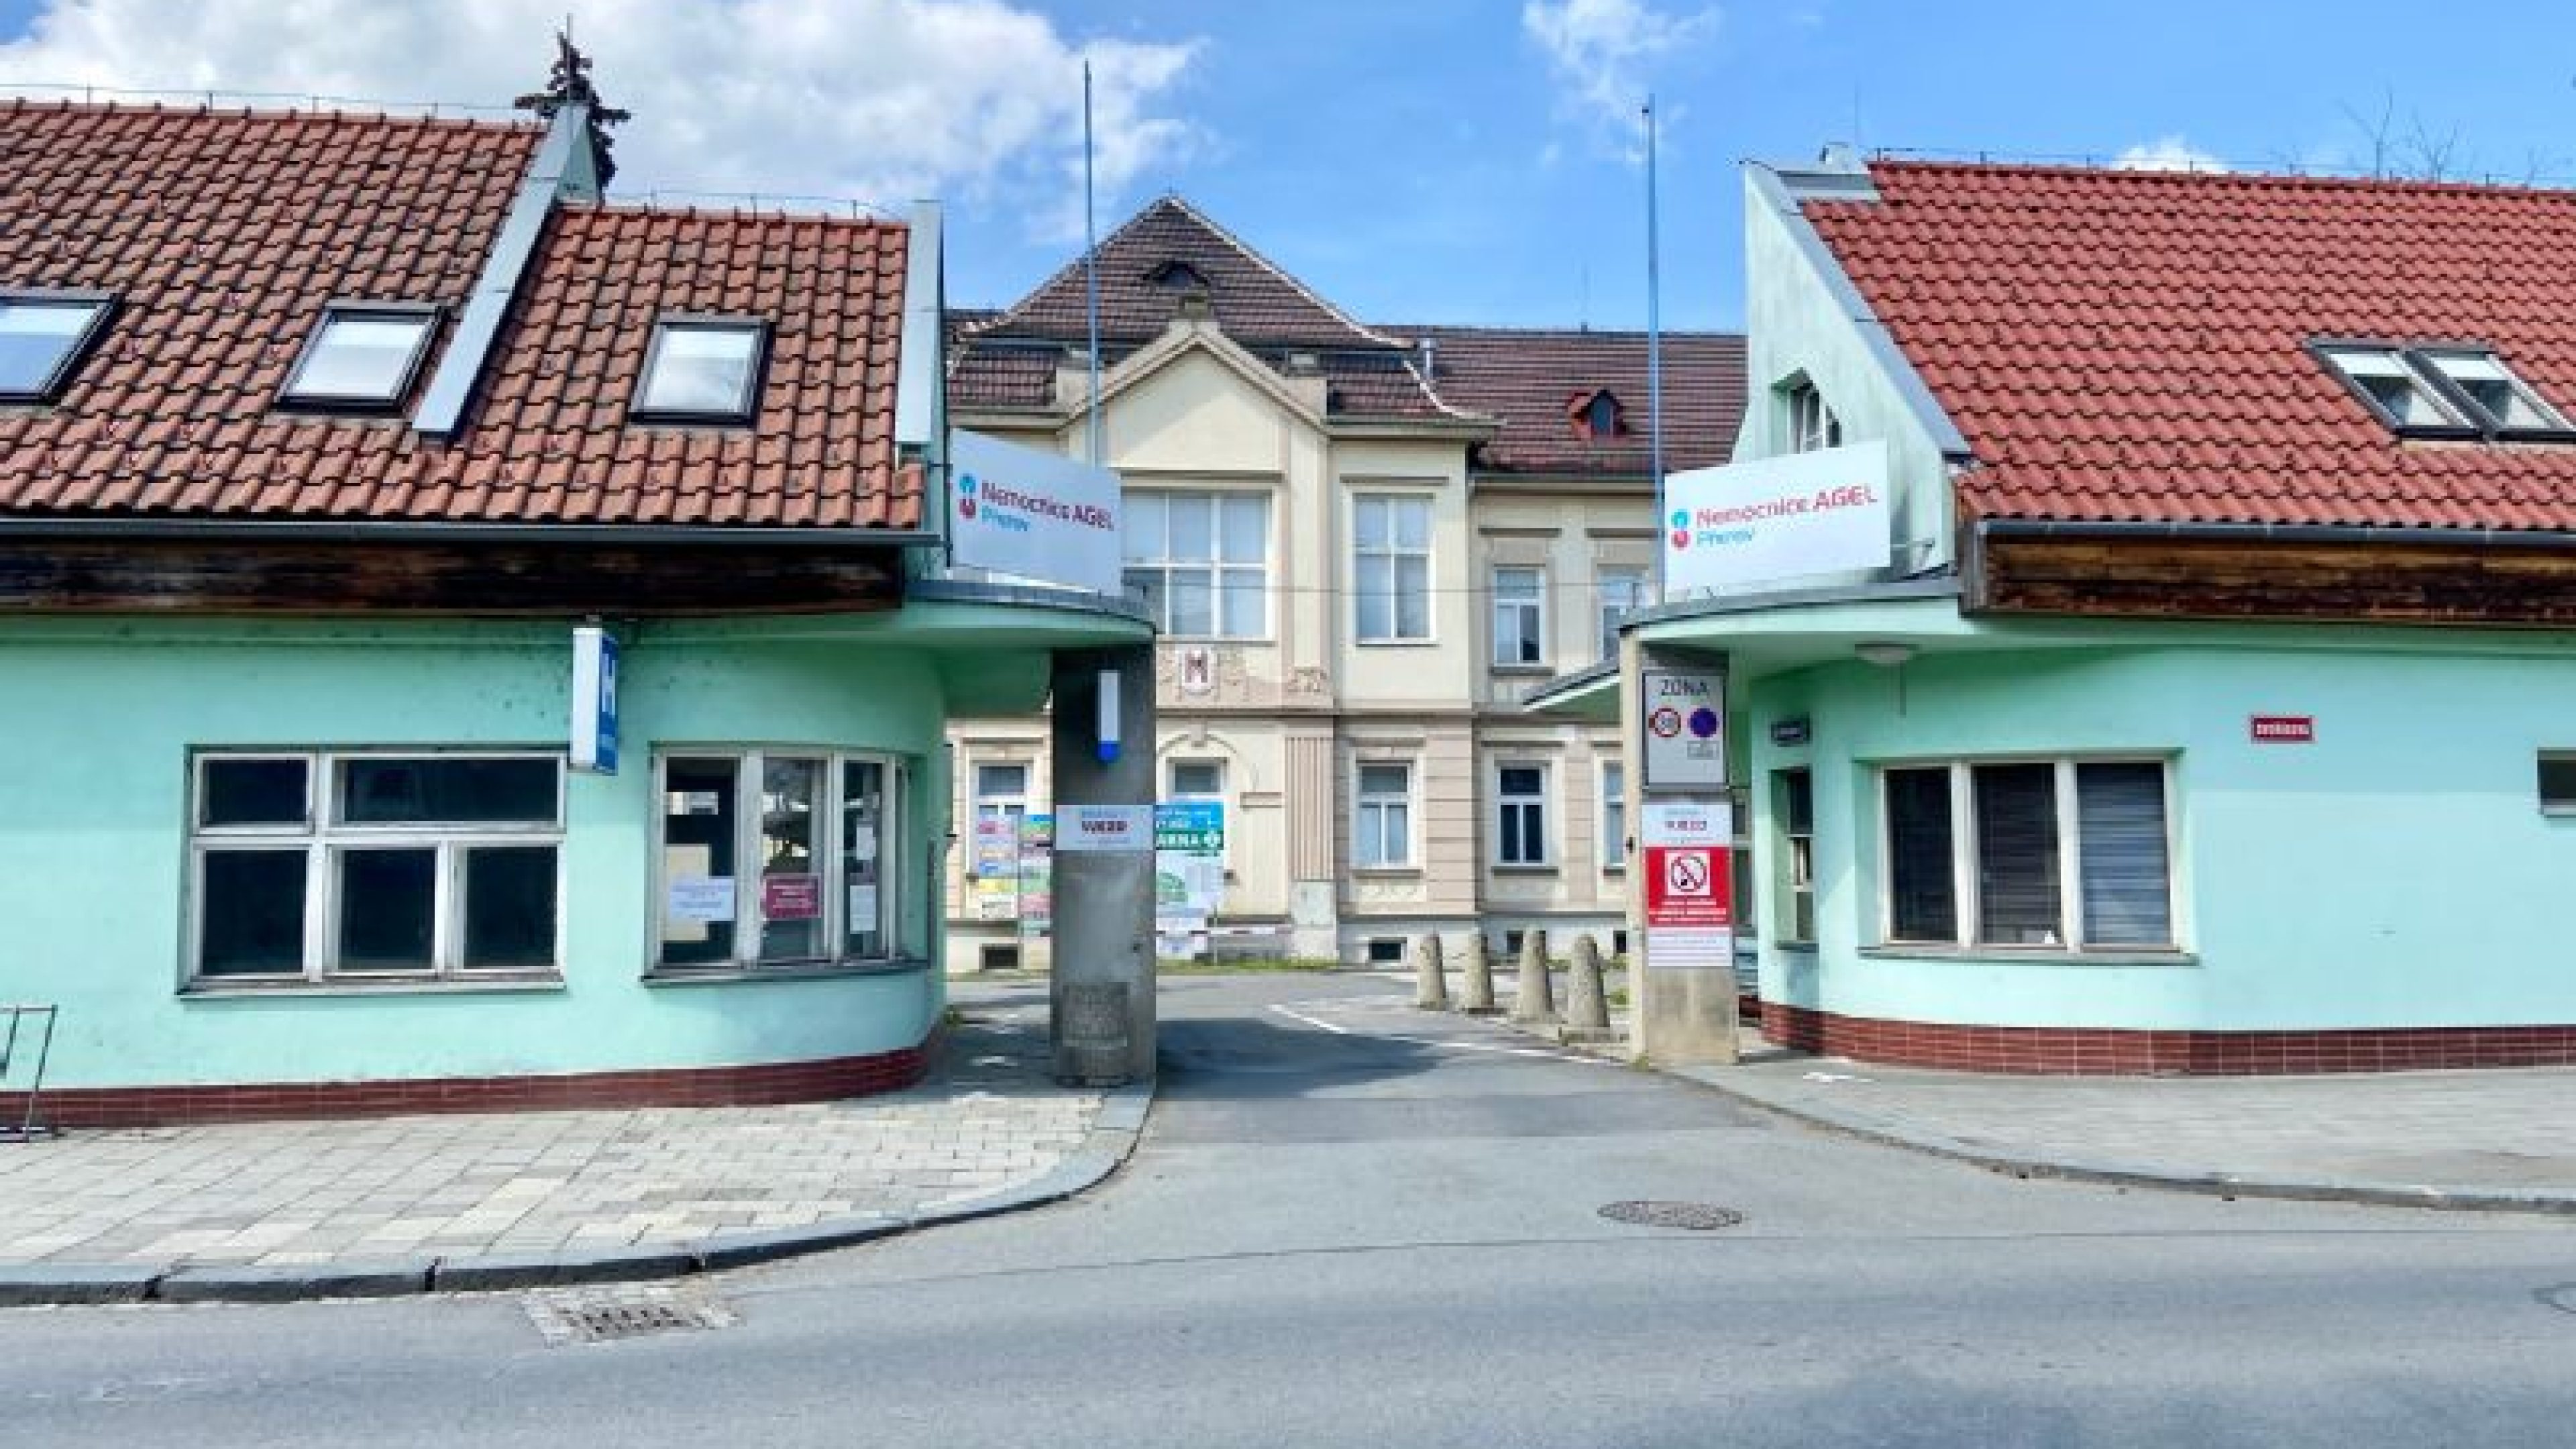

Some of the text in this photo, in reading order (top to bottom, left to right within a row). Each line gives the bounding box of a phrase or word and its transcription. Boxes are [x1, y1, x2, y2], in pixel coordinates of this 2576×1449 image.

[981, 481, 1115, 532] Nemocnice AGEL
[1697, 484, 1878, 527] Nemocnice AGEL
